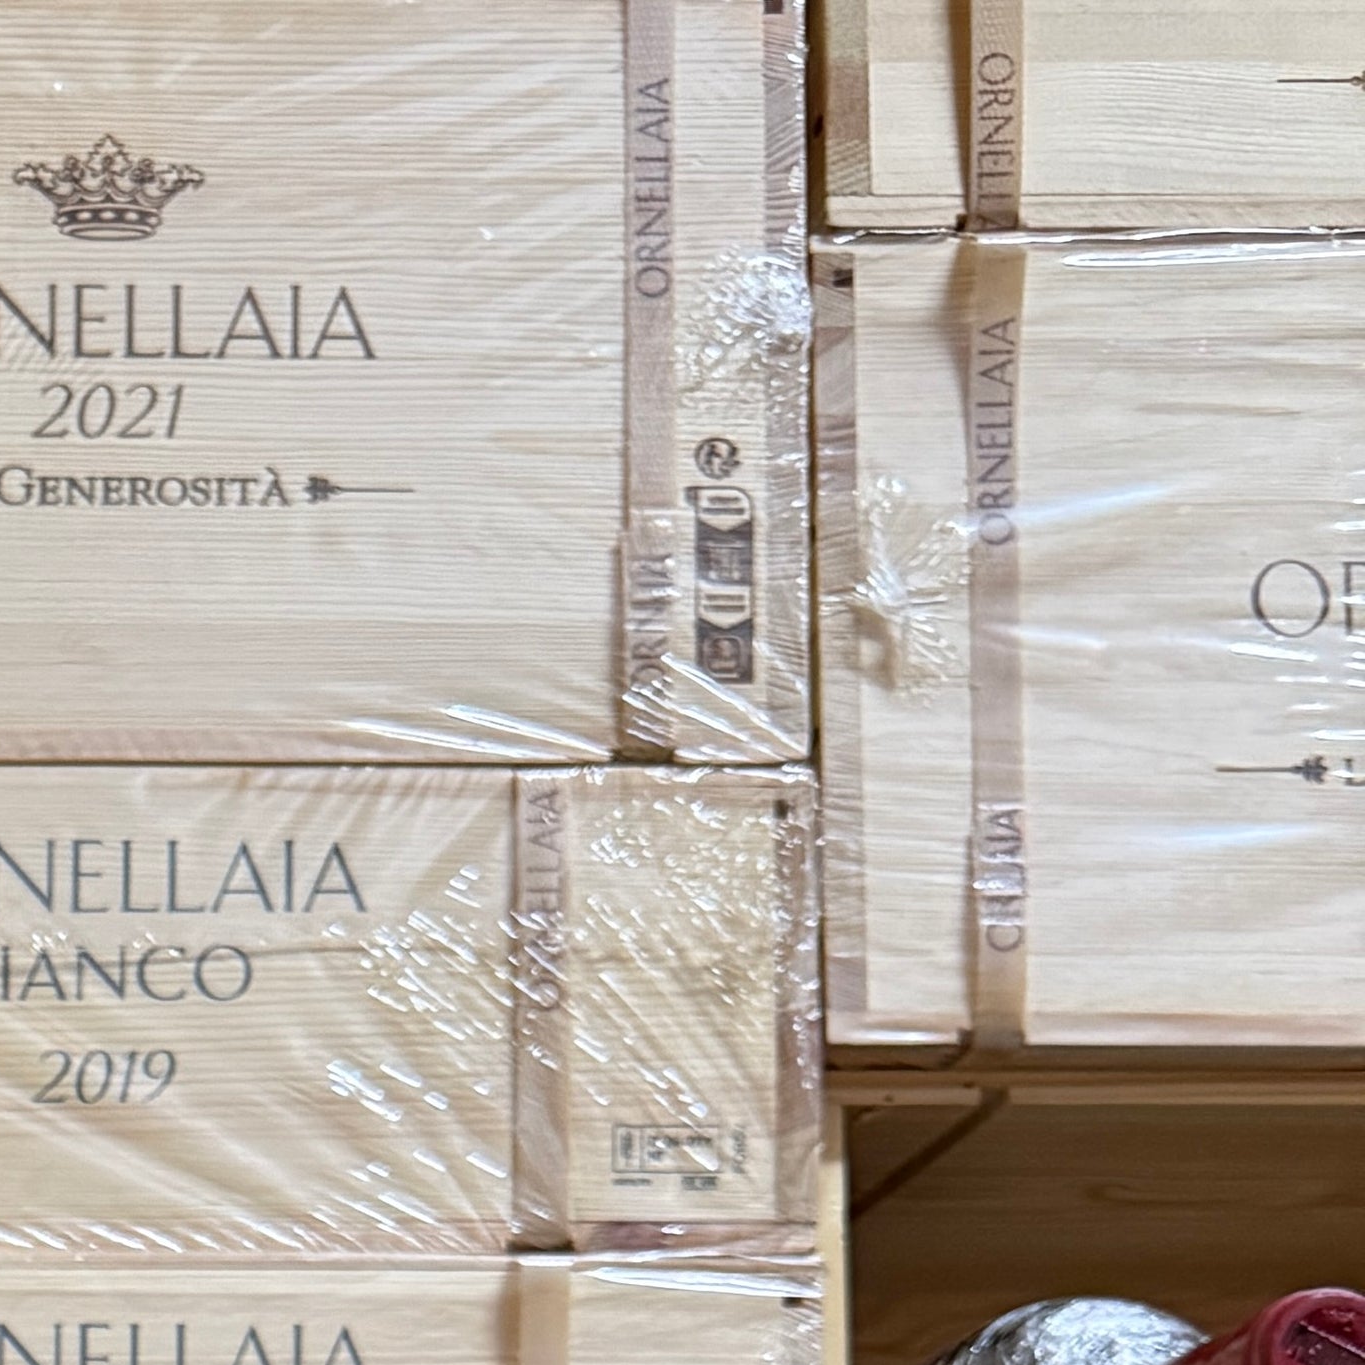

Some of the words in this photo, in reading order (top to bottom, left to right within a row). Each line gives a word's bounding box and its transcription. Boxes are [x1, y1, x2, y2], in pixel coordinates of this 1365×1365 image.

[635, 75, 670, 300] ORNELLAIA
[30, 382, 186, 440] 2021
[977, 315, 1018, 547] ORNELLAIA
[30, 1048, 178, 1104] 2019
